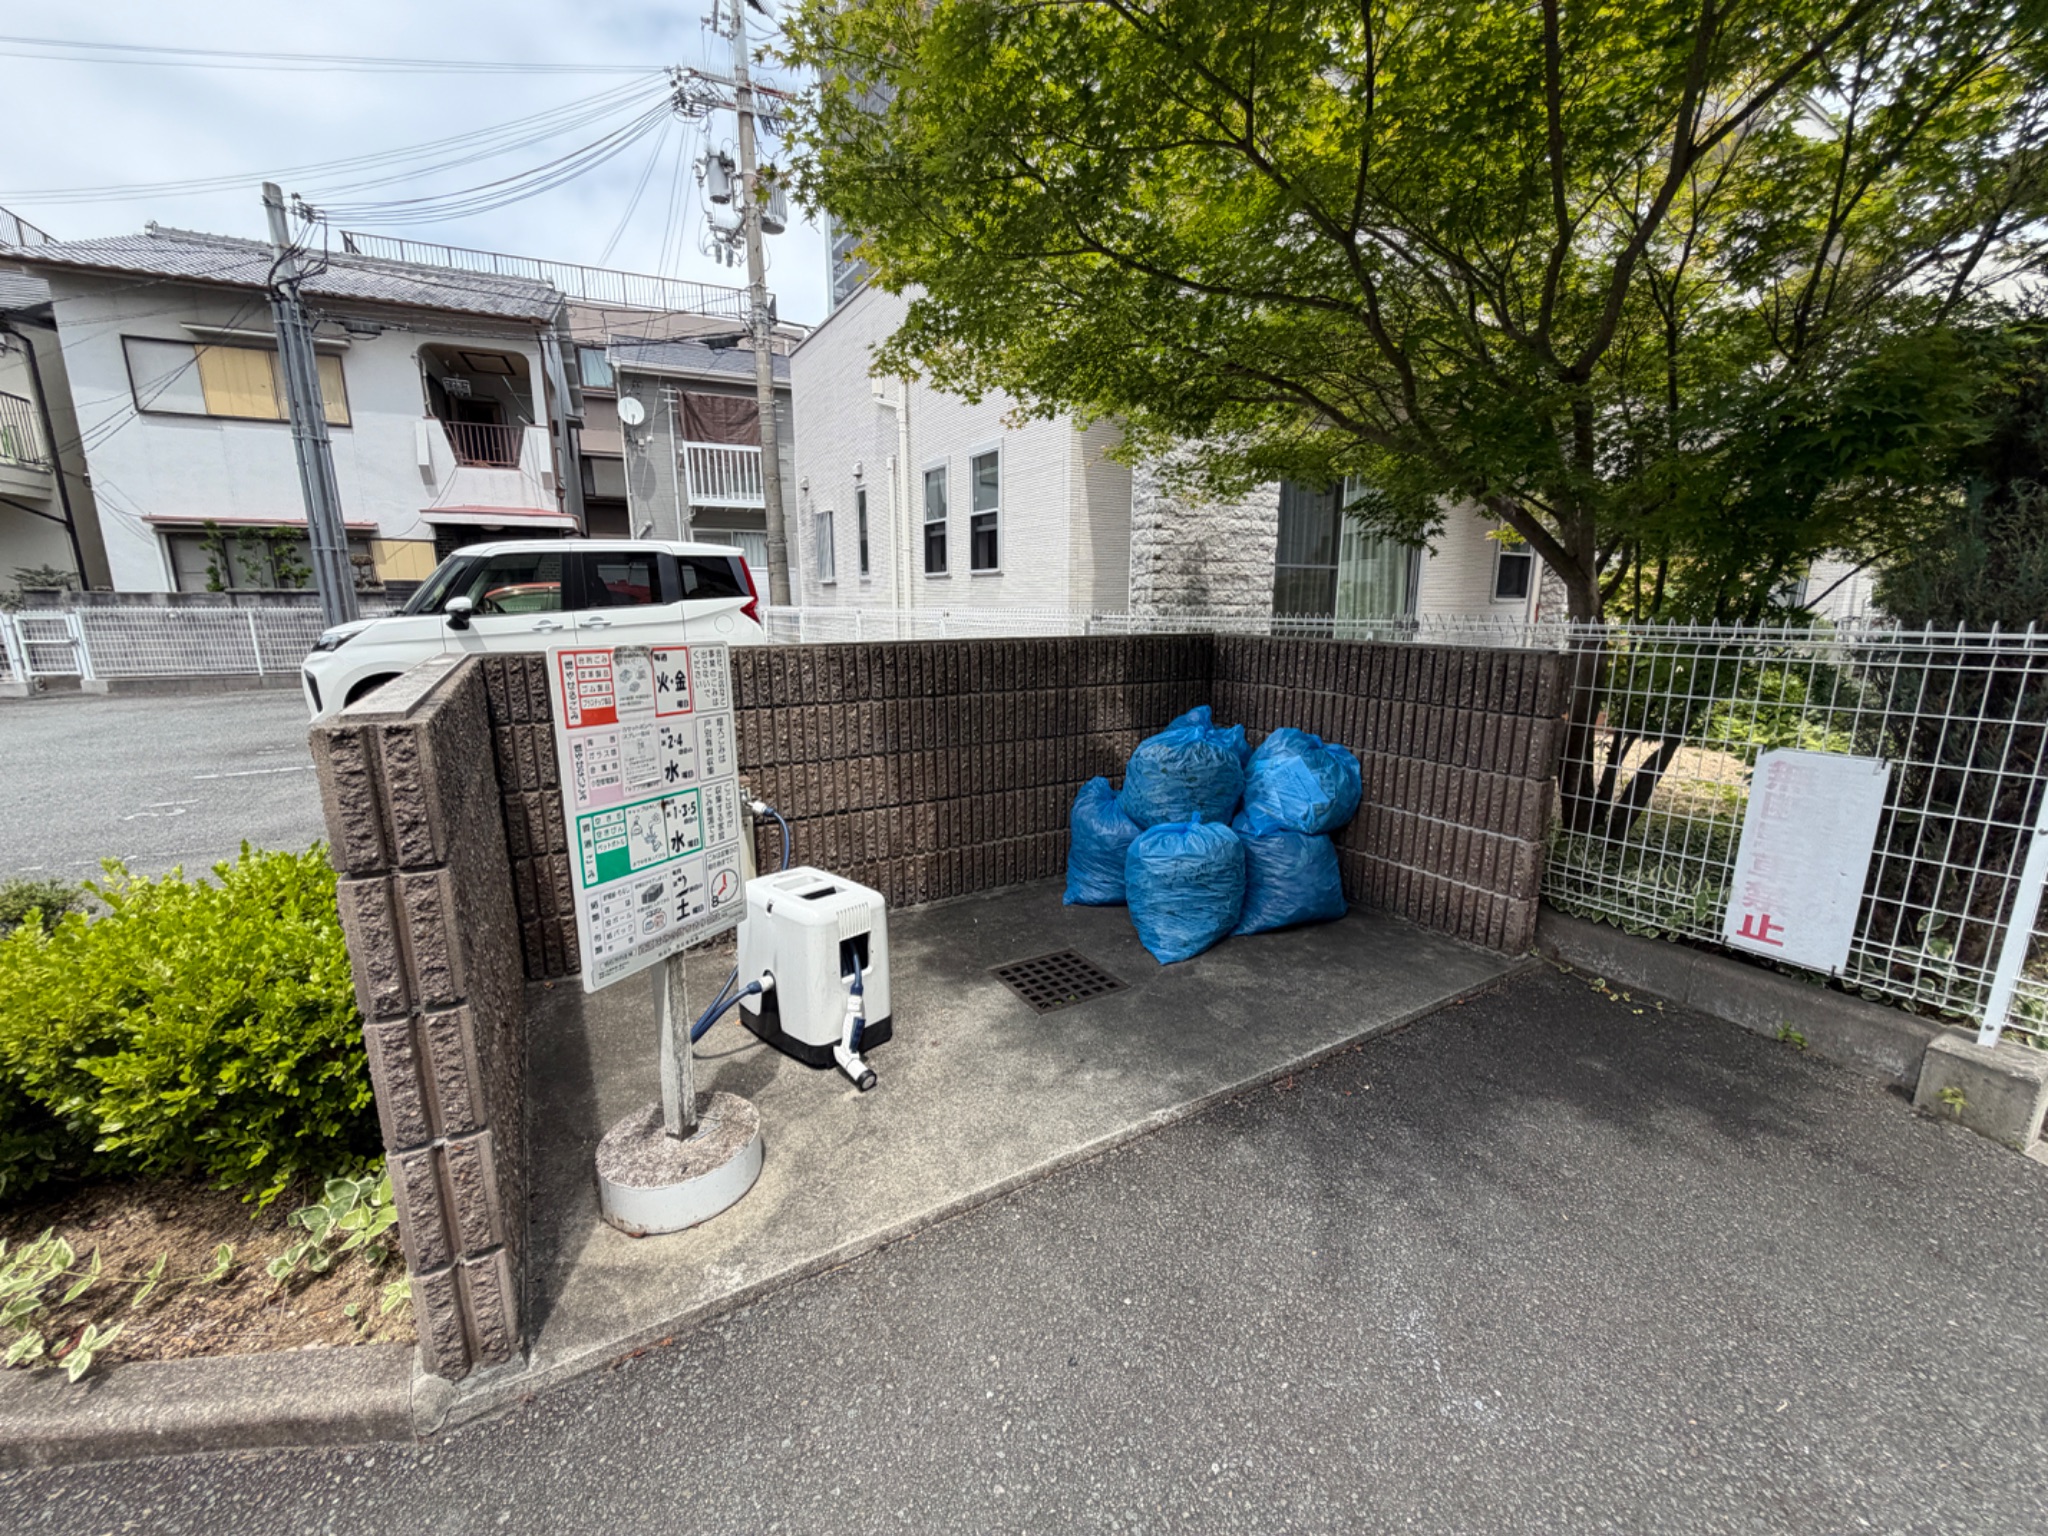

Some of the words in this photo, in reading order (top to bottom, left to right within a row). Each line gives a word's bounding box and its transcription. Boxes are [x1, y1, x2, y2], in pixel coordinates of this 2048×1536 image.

[692, 649, 702, 688] ください
[700, 649, 711, 698] 出さないで
[564, 660, 579, 720] 燃やせるごみ
[581, 683, 610, 693] ゴム製品
[582, 697, 611, 707] プラスチック製品
[676, 699, 688, 708] 曜日
[664, 760, 680, 783] 水
[597, 839, 624, 852] ペットボトル
[670, 830, 685, 853] 水
